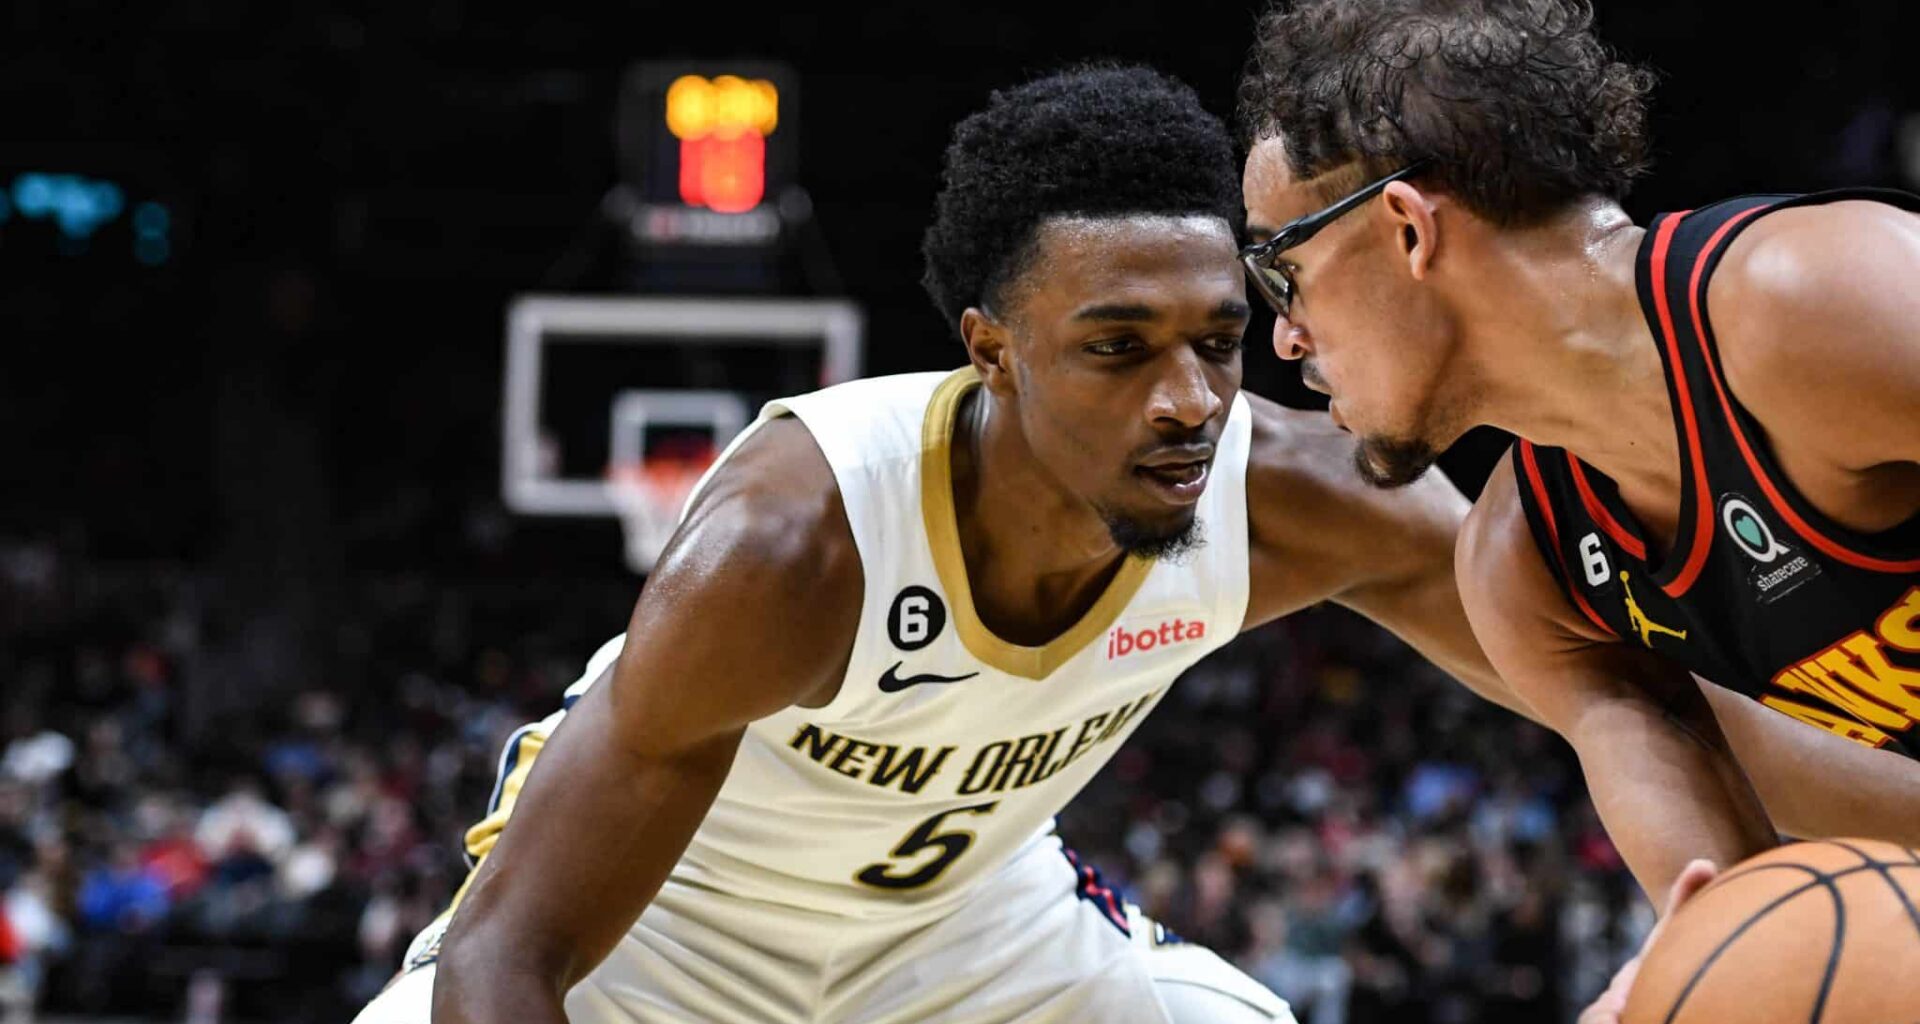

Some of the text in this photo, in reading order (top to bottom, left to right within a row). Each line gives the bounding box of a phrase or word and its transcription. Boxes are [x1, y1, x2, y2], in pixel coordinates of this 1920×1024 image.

[1579, 532, 1610, 587] 6
[1757, 554, 1809, 592] sharecare
[899, 596, 931, 643] 6
[1108, 618, 1206, 660] ibotta
[787, 722, 956, 795] NEW
[853, 800, 1000, 889] 5
